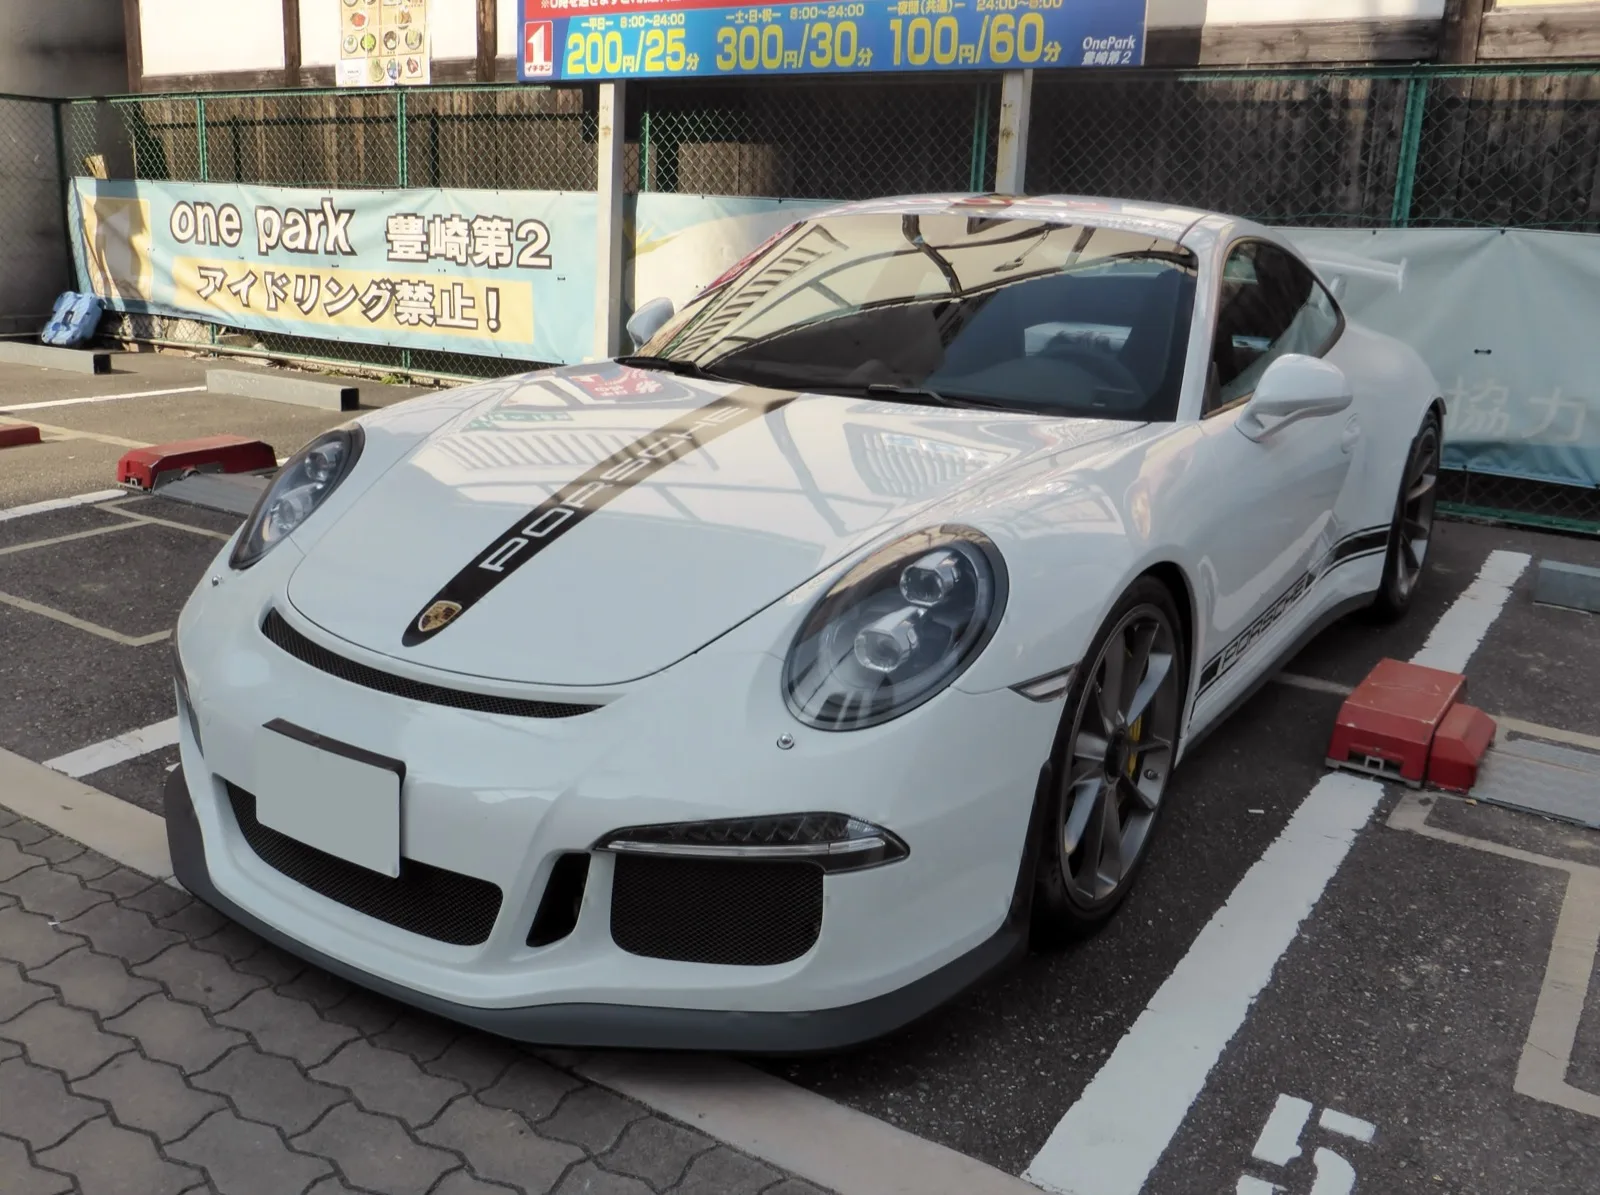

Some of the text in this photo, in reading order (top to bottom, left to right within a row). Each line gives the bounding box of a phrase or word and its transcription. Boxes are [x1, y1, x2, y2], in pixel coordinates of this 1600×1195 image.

[1082, 35, 1136, 51] OnePark
[170, 197, 553, 270] one park 豊崎第2
[479, 405, 749, 572] PORSCHE
